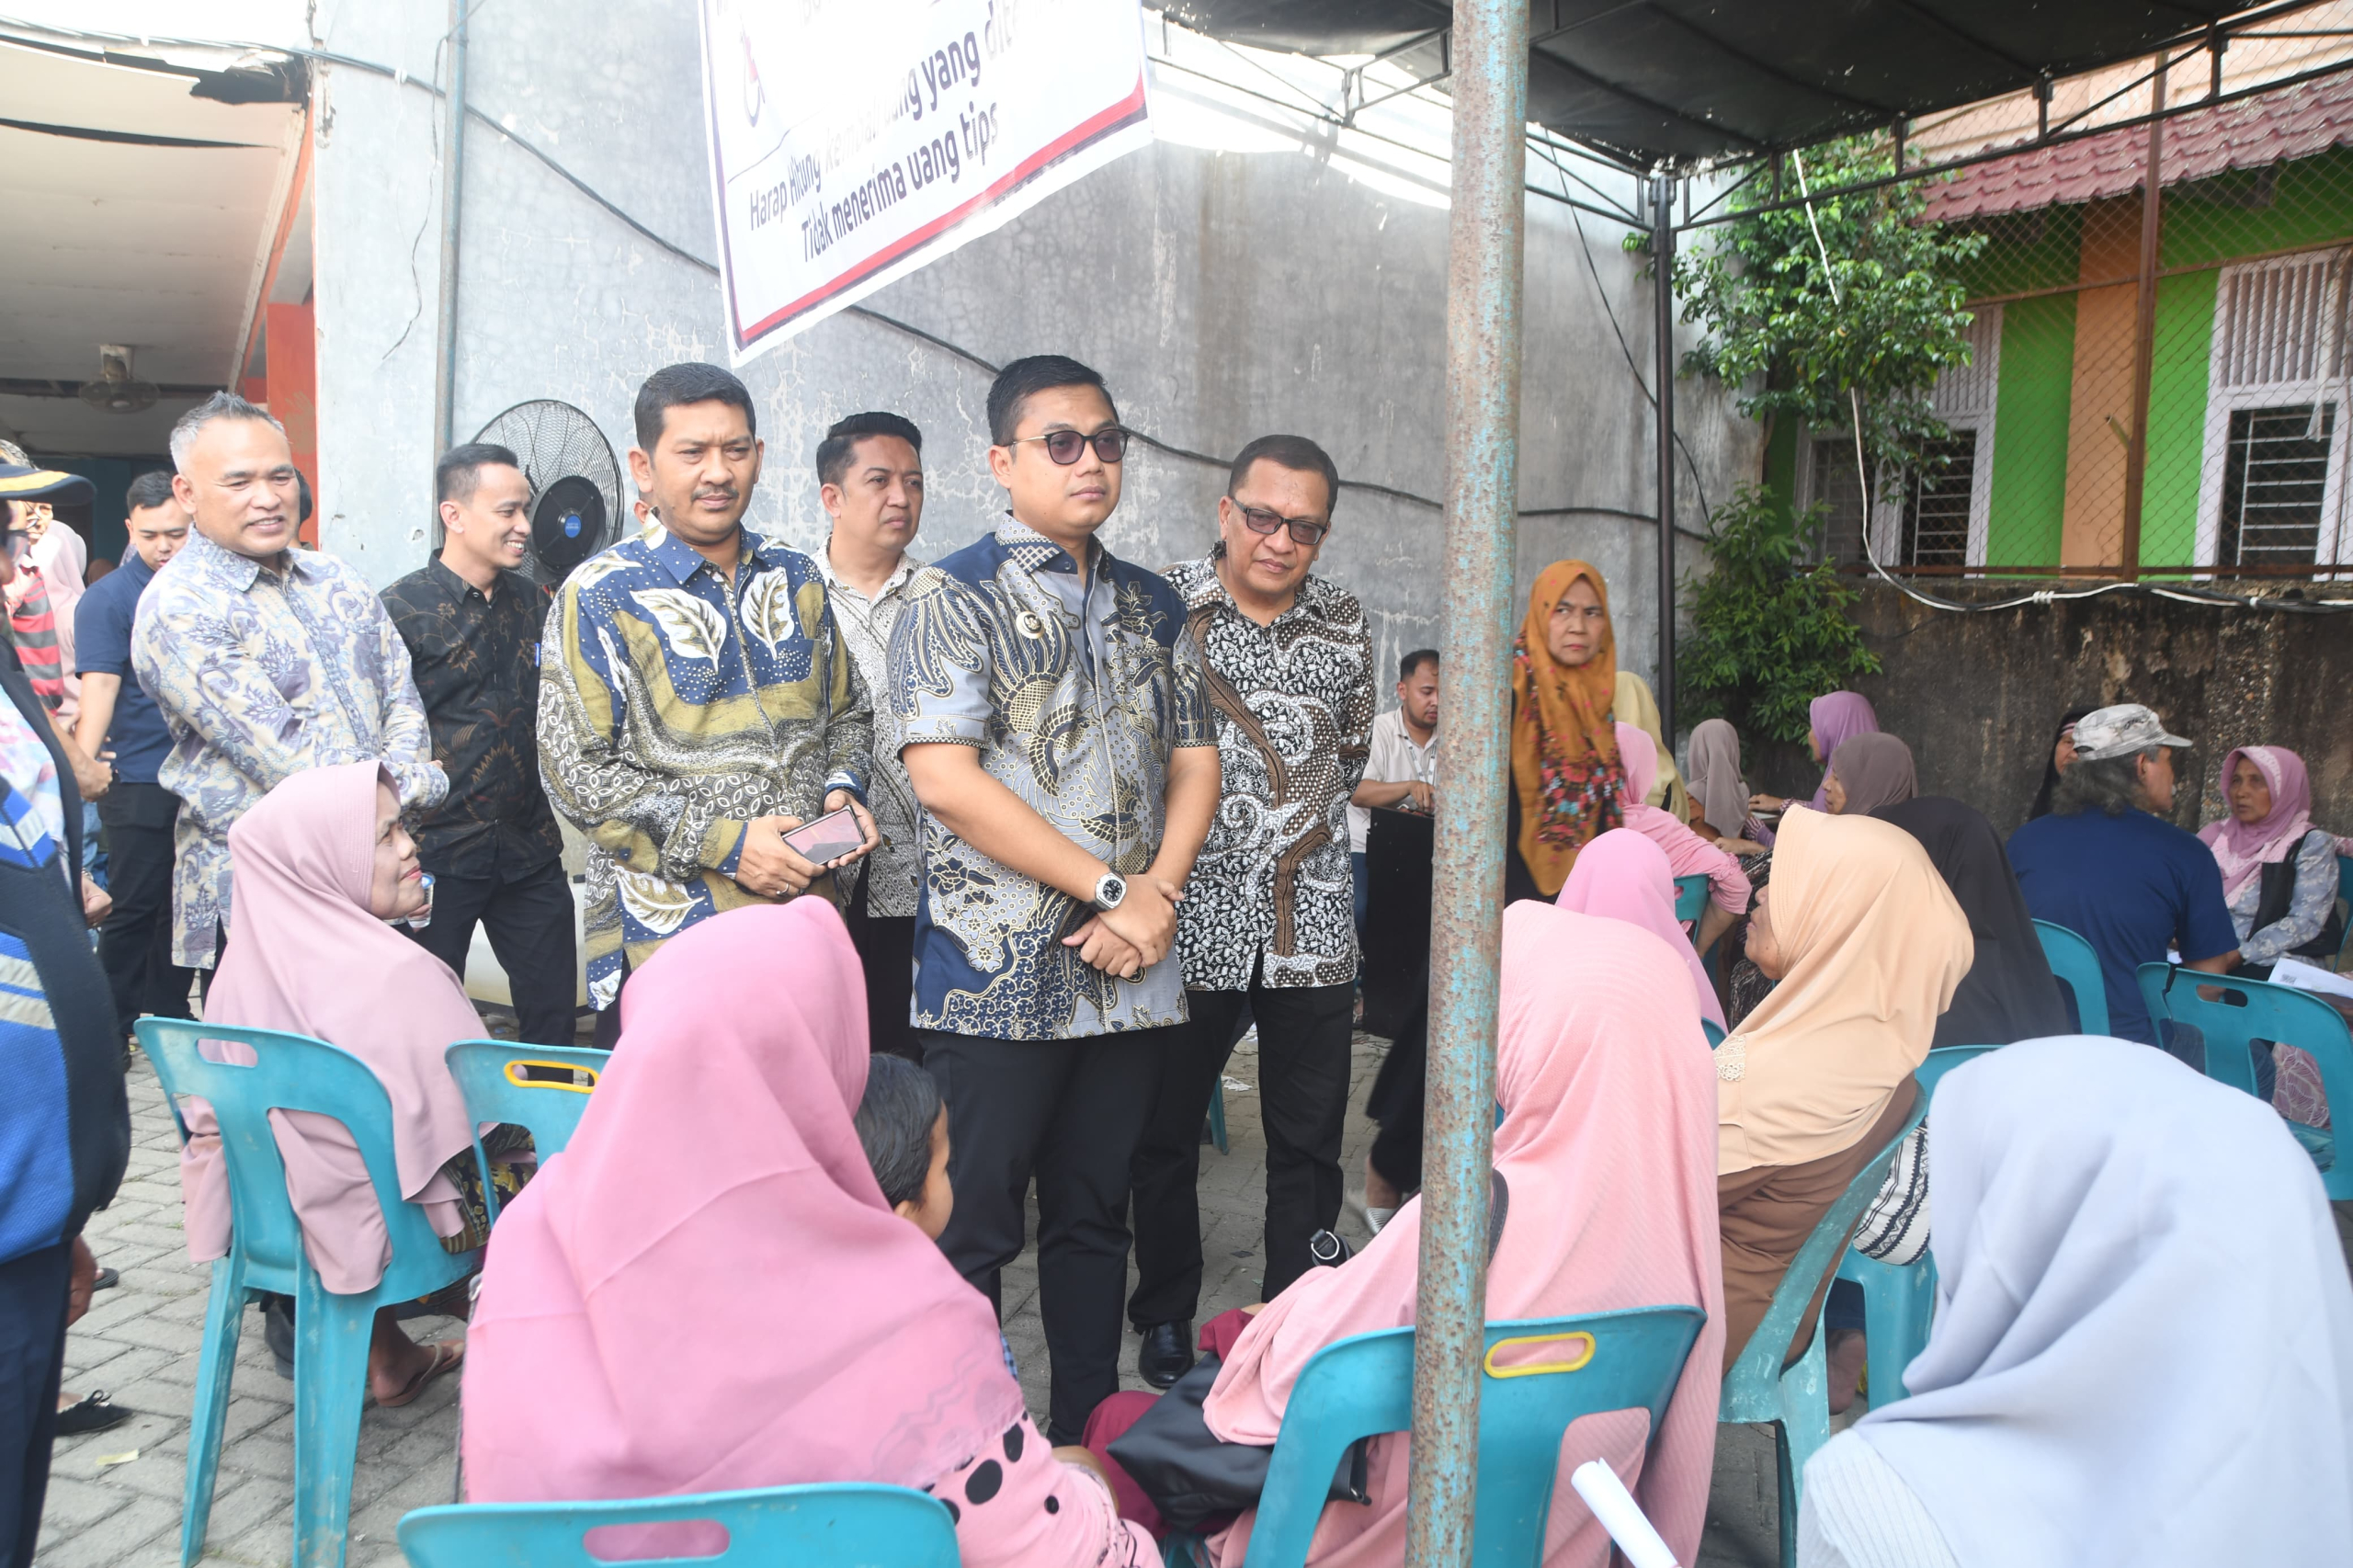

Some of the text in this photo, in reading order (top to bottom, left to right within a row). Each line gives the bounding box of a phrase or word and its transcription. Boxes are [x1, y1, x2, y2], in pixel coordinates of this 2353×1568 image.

[748, 180, 788, 231] Harap
[788, 150, 821, 207] Hitung
[883, 67, 924, 121] uang
[921, 30, 982, 111] yang
[801, 99, 999, 263] Tidak menerima uang tips
